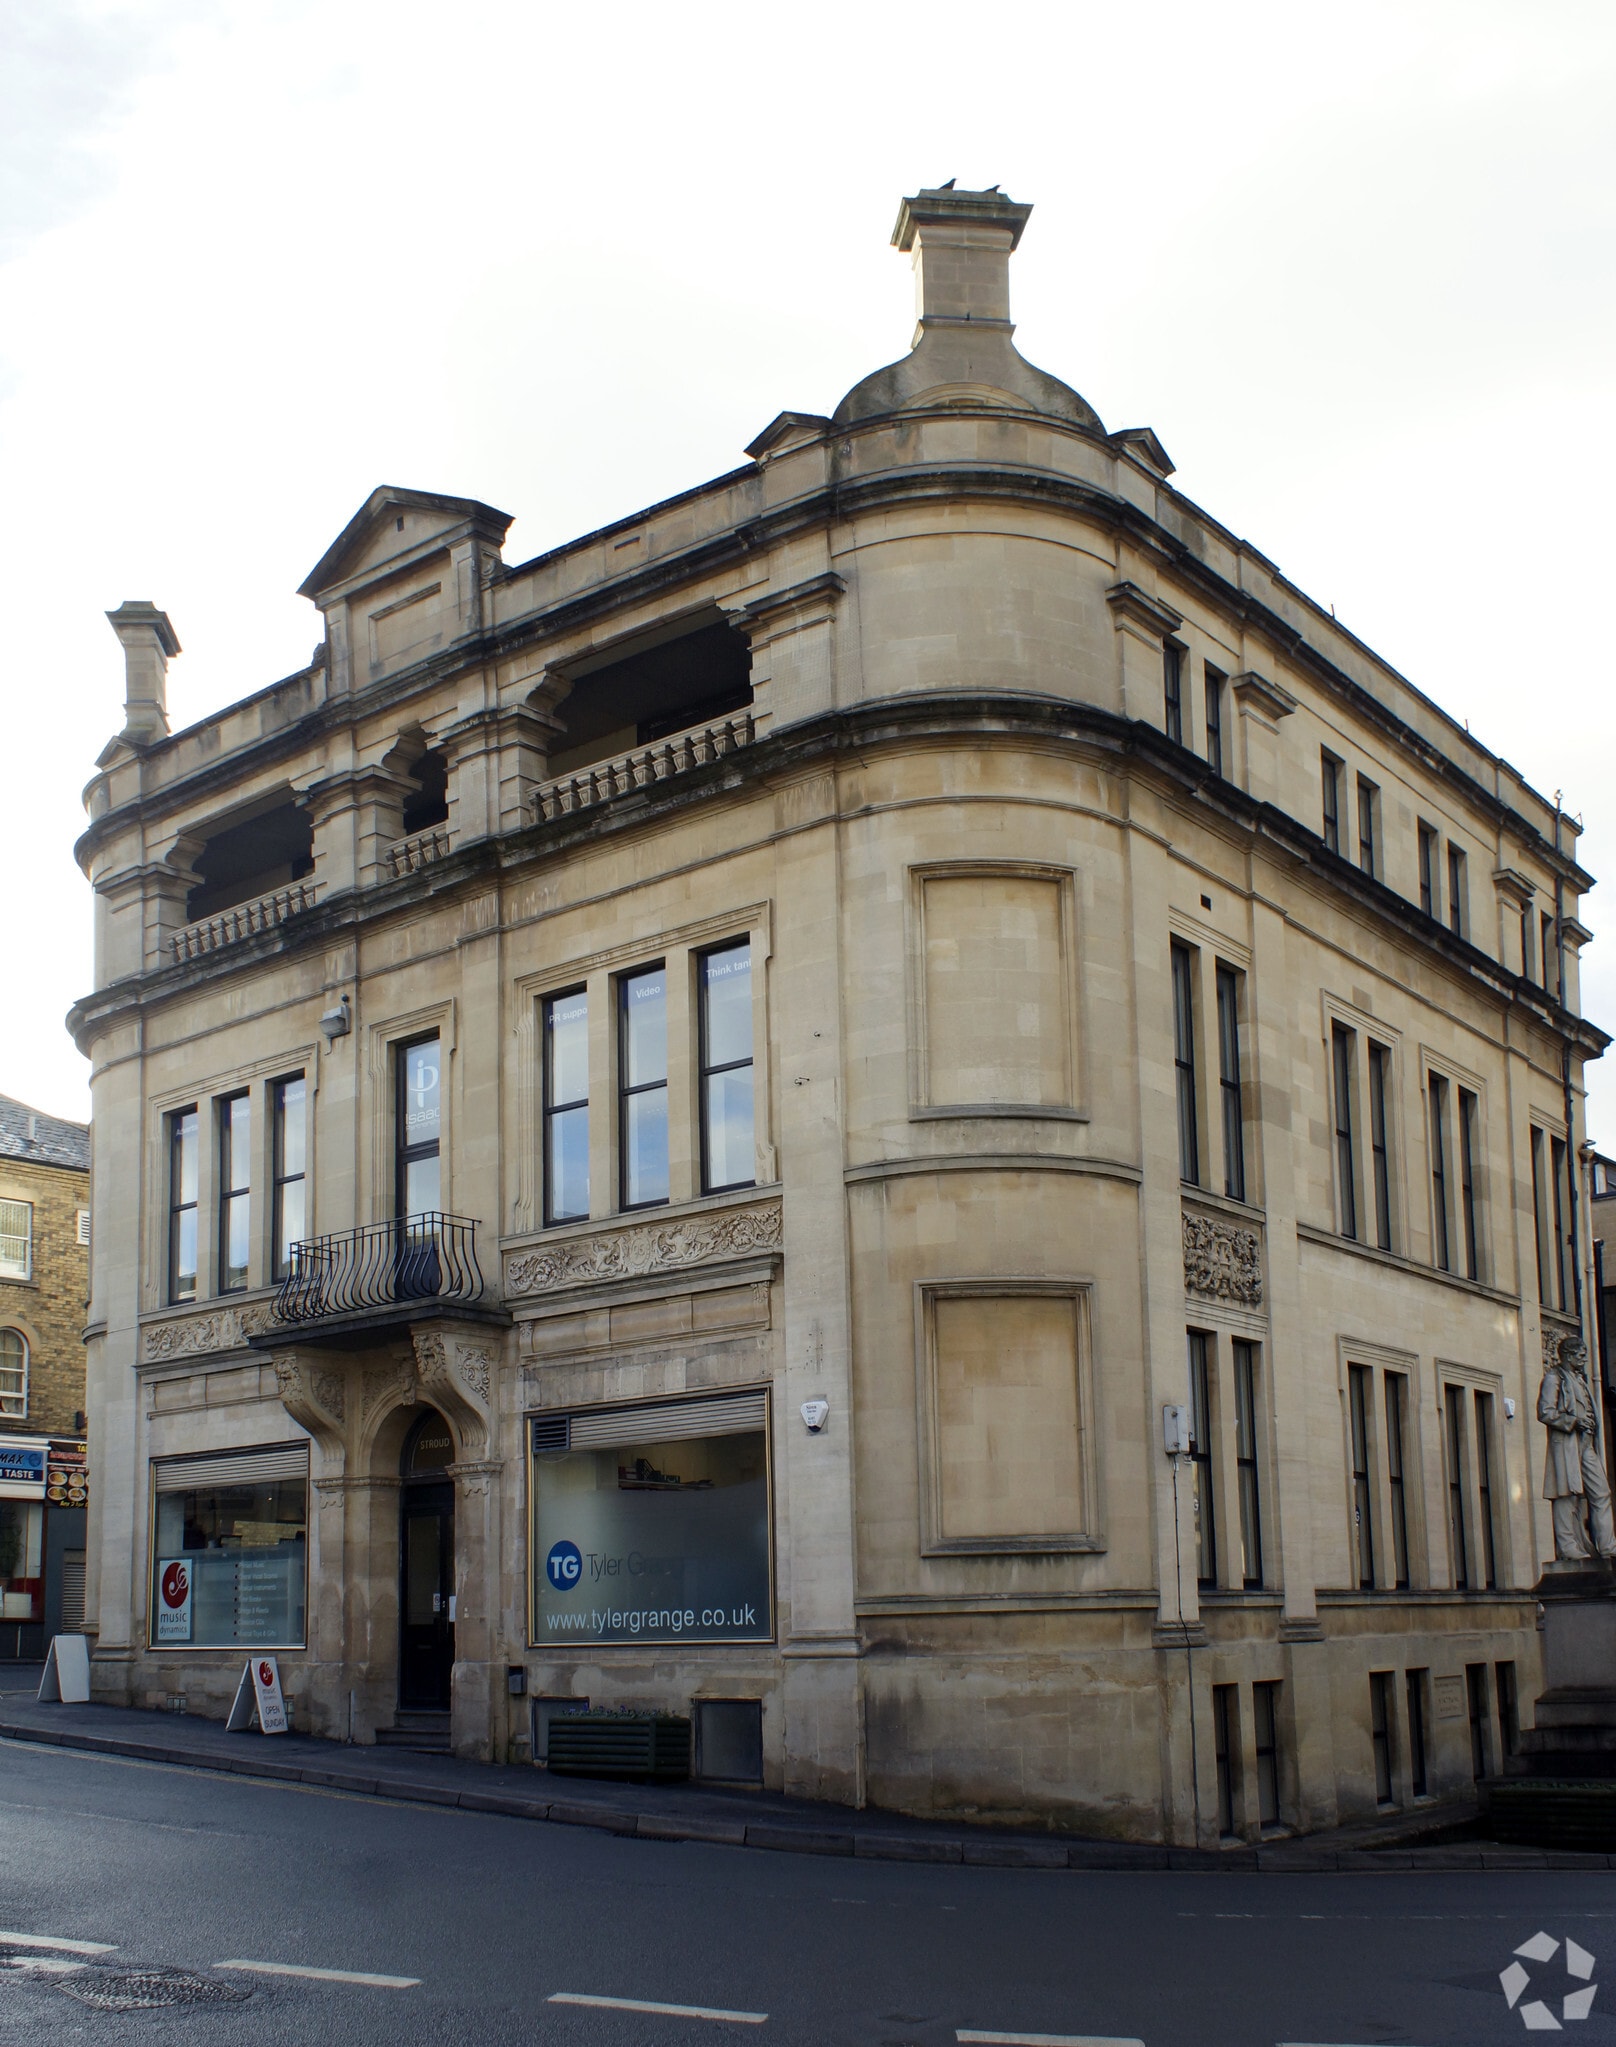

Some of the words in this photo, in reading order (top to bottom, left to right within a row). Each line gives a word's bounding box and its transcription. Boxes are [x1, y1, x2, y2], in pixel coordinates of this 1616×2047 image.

[706, 964, 732, 979] Think
[636, 984, 661, 999] Video
[549, 1011, 561, 1025] PR
[562, 1006, 588, 1022] suppo
[420, 1437, 450, 1450] STROUD
[5, 1469, 35, 1479] TASTE
[551, 1555, 579, 1580] TG
[586, 1552, 623, 1583] Tyler
[160, 1609, 187, 1623] music
[546, 1602, 756, 1636] www.tylergrange.co.uk
[159, 1625, 187, 1636] dynamics
[265, 1705, 281, 1715] OPEN
[264, 1718, 285, 1728] SUNDAY
